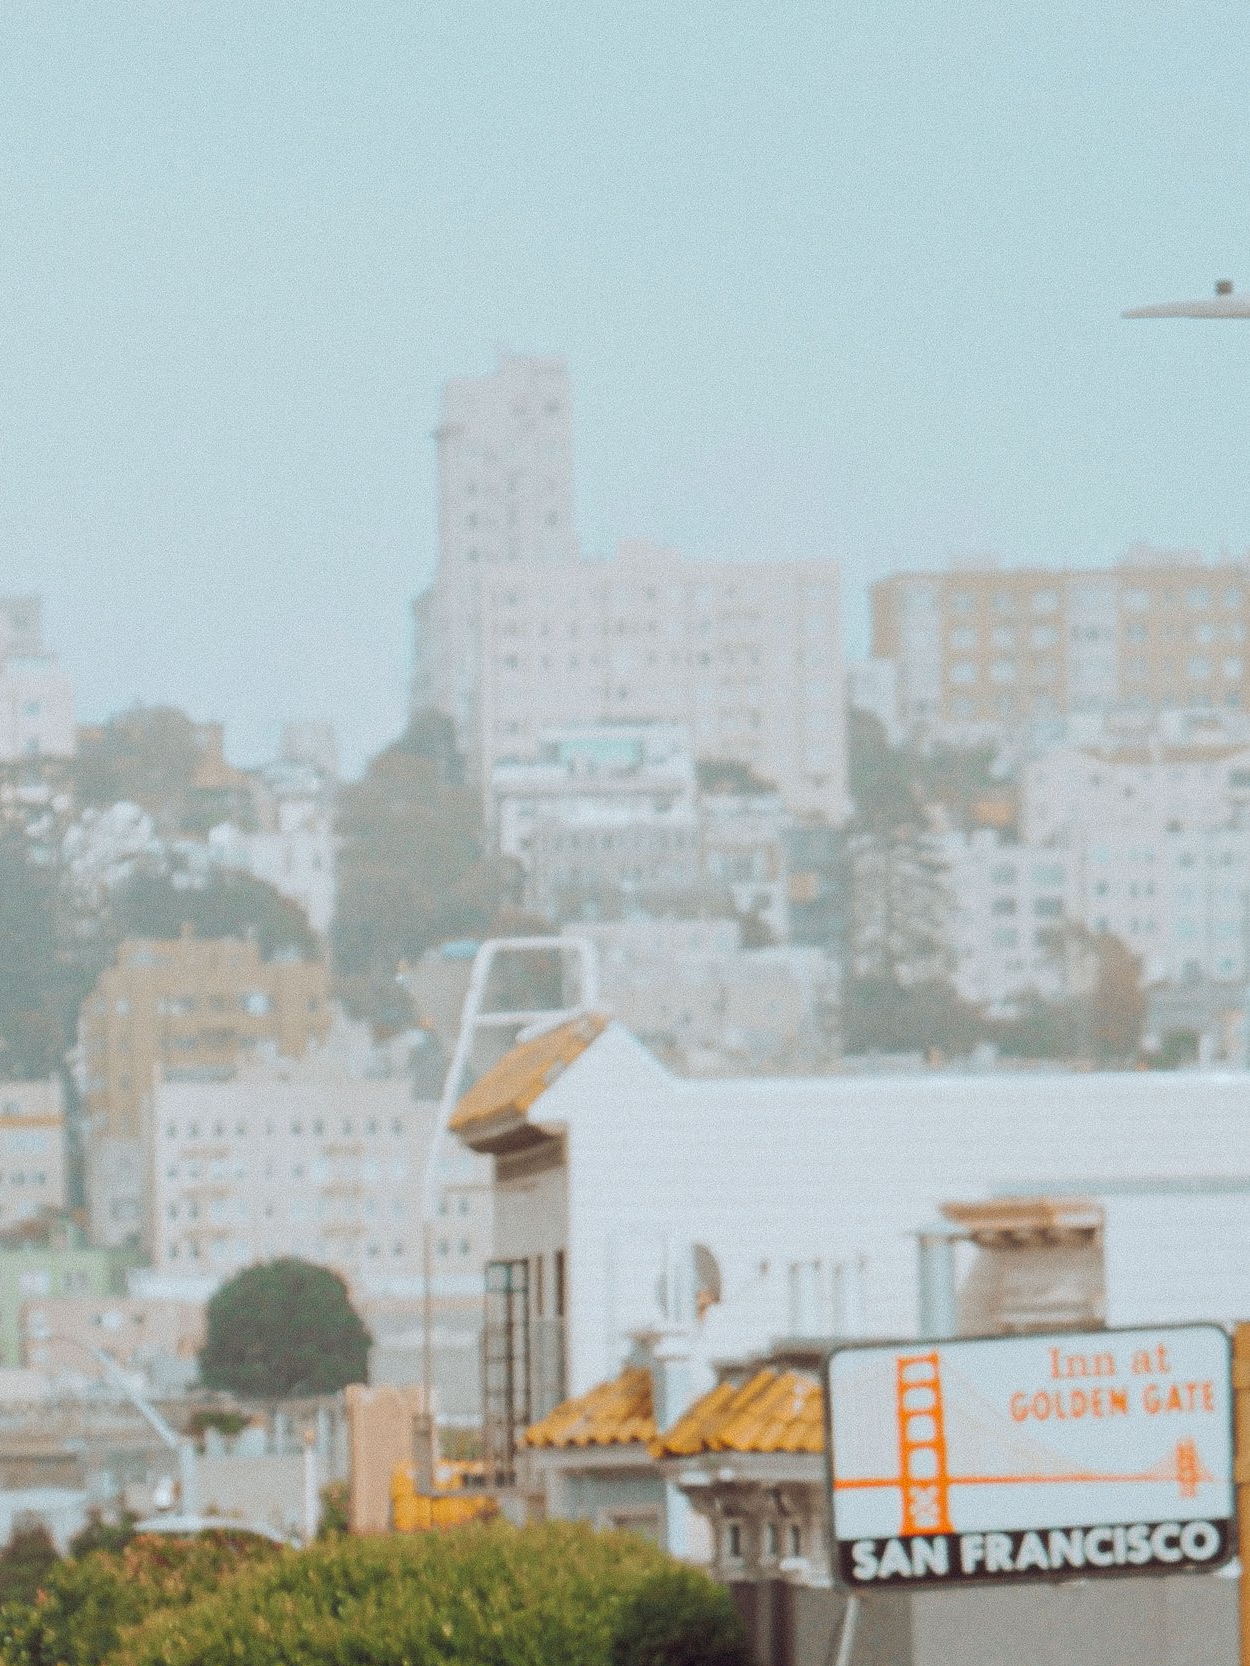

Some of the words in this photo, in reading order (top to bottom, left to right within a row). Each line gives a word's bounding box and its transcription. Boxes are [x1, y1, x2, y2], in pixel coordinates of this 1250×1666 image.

[1049, 1346, 1116, 1380] Inn
[1131, 1342, 1172, 1375] at
[1008, 1385, 1129, 1423] GOLDEN
[1142, 1381, 1215, 1415] GATE
[850, 1536, 949, 1582] SAN
[958, 1520, 1221, 1575] FRANCISCO
